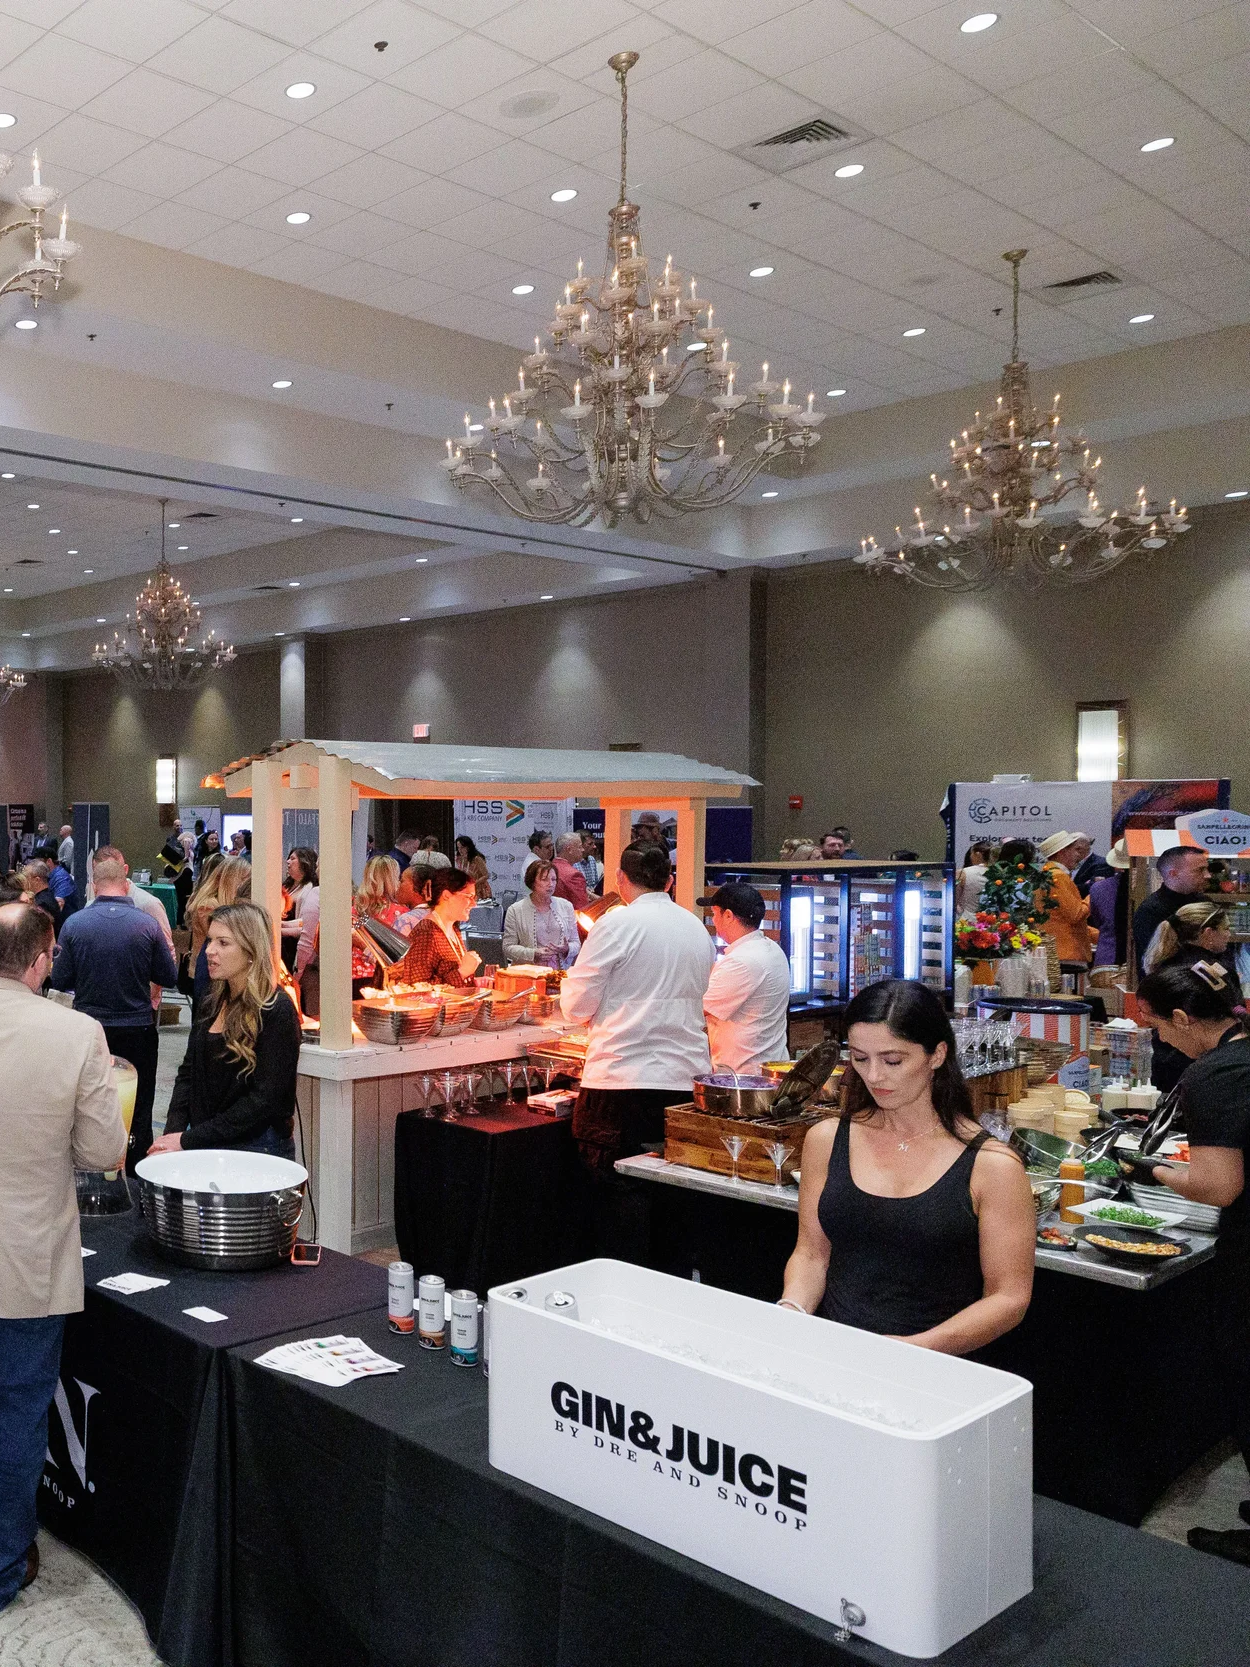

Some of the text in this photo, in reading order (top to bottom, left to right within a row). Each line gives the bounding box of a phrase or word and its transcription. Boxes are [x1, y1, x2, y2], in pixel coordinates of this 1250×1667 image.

[977, 805, 1052, 816] CAPITOL
[582, 821, 602, 830] Your
[1204, 836, 1247, 845] CIAO!
[551, 1381, 808, 1515] GIN&JUICE
[554, 1419, 808, 1532] BY DRE AND SNOOP
[43, 1474, 75, 1509] NOOP
